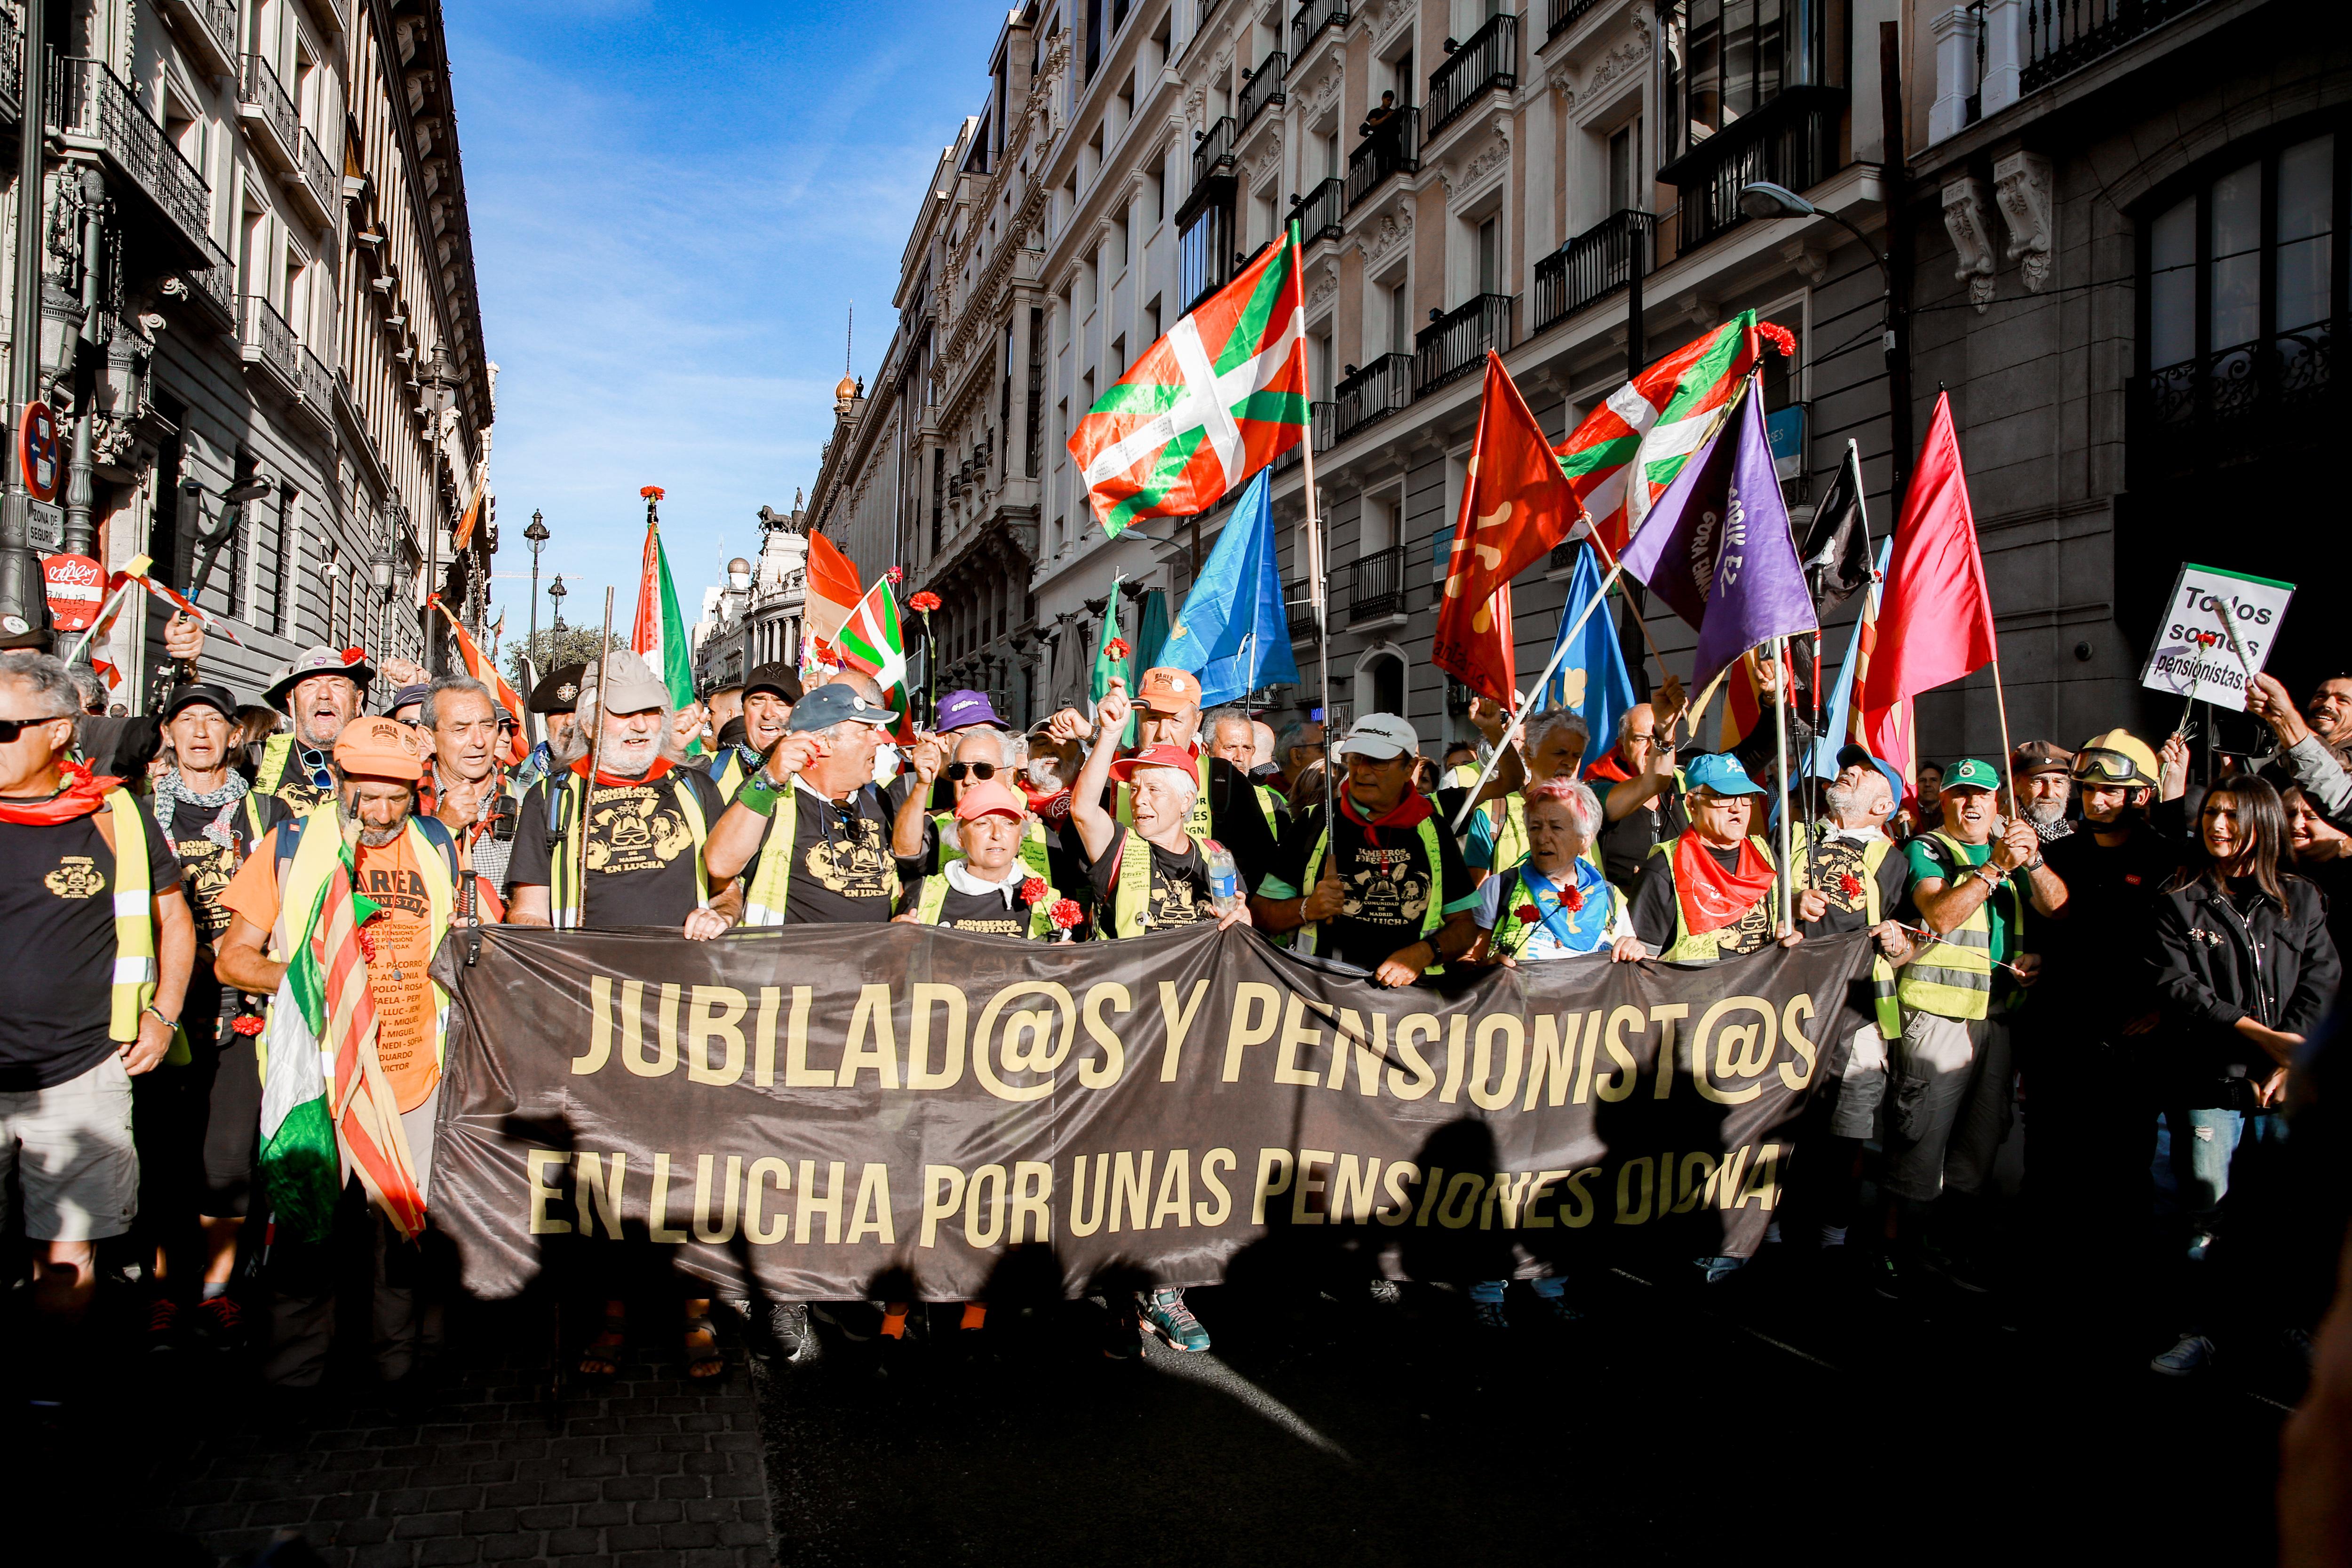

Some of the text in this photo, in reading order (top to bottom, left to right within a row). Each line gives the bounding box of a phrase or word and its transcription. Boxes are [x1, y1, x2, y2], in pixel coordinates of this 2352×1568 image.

[33, 509, 57, 525] ZONA DE
[31, 526, 55, 544] SEGURID
[2186, 587, 2272, 625] Toos
[611, 843, 653, 852] COMUNIDAD
[604, 860, 666, 874] EN LUCHA
[355, 870, 429, 901] AREA
[843, 889, 859, 898] EN
[372, 897, 418, 908] ONISTA
[1829, 897, 1852, 914] UCHA
[209, 919, 231, 929] LUC
[380, 972, 419, 981] ANONIA
[404, 982, 423, 991] ROSA
[406, 994, 421, 1003] PEPI
[383, 1007, 404, 1016] LLUC
[394, 1015, 419, 1026] MIQUEL
[387, 1027, 415, 1038] MIGUEL
[381, 1036, 423, 1050] NEDI SOFIA
[571, 974, 1817, 1112] JUBILAD@S Y PENSIONIST@S
[379, 1051, 413, 1061] DUARDO
[527, 1143, 1795, 1249] EN LUCHA POR UNAS PENSIONES DIGNA
